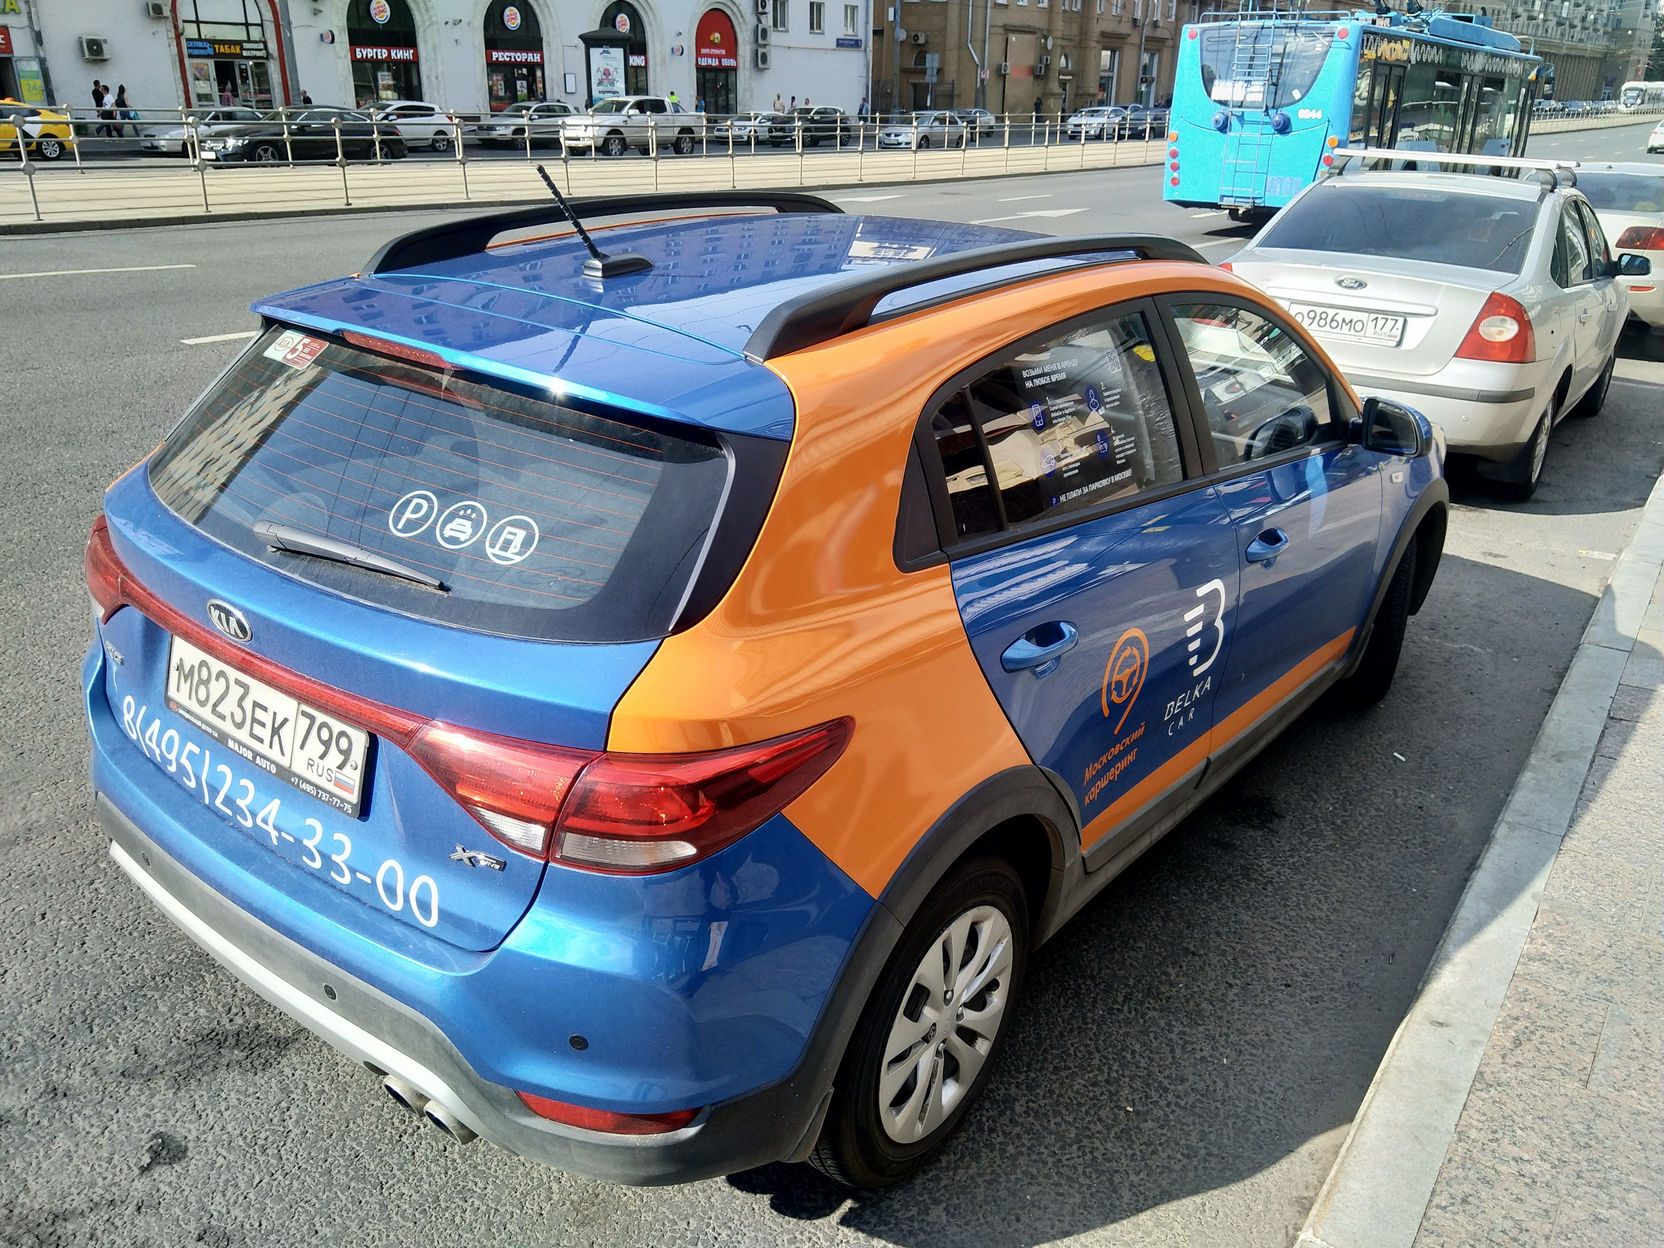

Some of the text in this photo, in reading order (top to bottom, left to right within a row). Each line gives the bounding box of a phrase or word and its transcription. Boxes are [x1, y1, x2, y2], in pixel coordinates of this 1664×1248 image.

[214, 44, 241, 54] ТАБАК
[355, 47, 414, 60] БУРГЕР КИНГ
[492, 51, 541, 62] РЕСТОРАН
[629, 55, 645, 67] KING
[698, 57, 719, 66] ОДЕЖДА
[1370, 316, 1399, 333] 177
[210, 605, 245, 639] KIA
[1164, 675, 1212, 722] BELKA
[176, 656, 353, 771] М823ЕК 799
[1168, 706, 1195, 737] CAR
[227, 738, 277, 774] MAJOR AUTO
[1083, 721, 1146, 787] Московский
[306, 758, 334, 782] RUS
[1084, 748, 1138, 807] каршеринг
